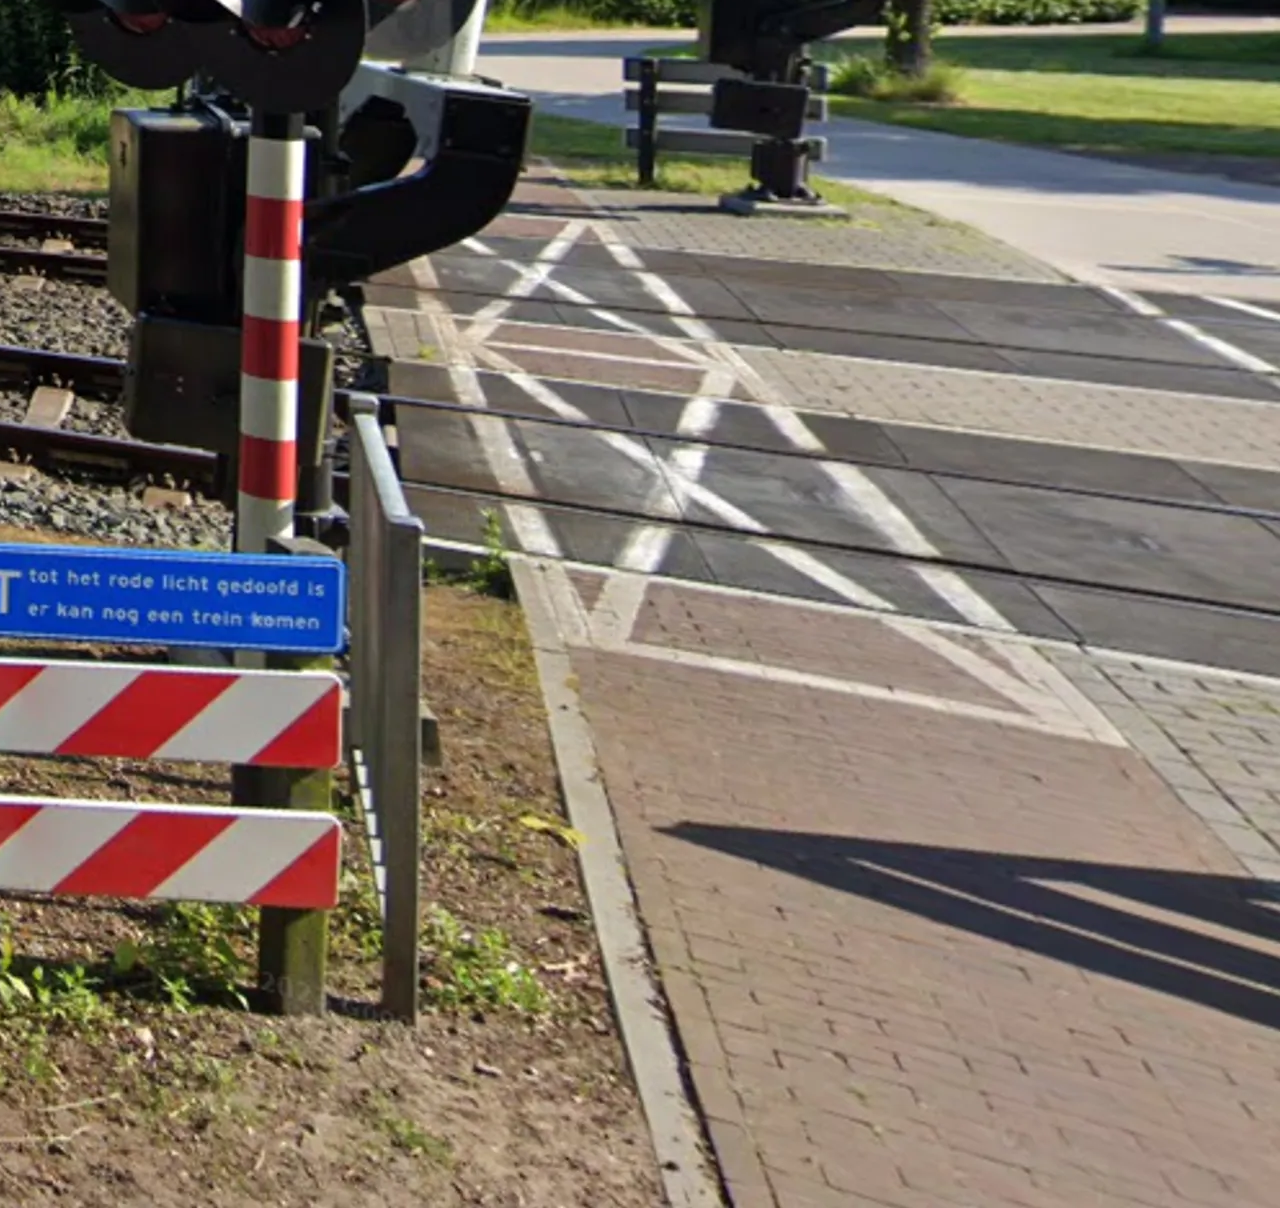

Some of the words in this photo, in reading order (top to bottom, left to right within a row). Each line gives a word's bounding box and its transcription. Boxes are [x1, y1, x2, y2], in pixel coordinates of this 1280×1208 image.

[29, 568, 58, 585] tot
[68, 569, 101, 587] het
[109, 572, 154, 589] rode
[162, 574, 209, 591] licht
[217, 578, 299, 596] gedoofd
[307, 581, 325, 597] is
[28, 602, 49, 617] er
[56, 601, 93, 619] kan
[102, 605, 139, 625] nog
[147, 609, 184, 624] een
[192, 609, 243, 627] trein
[251, 611, 320, 630] komen
